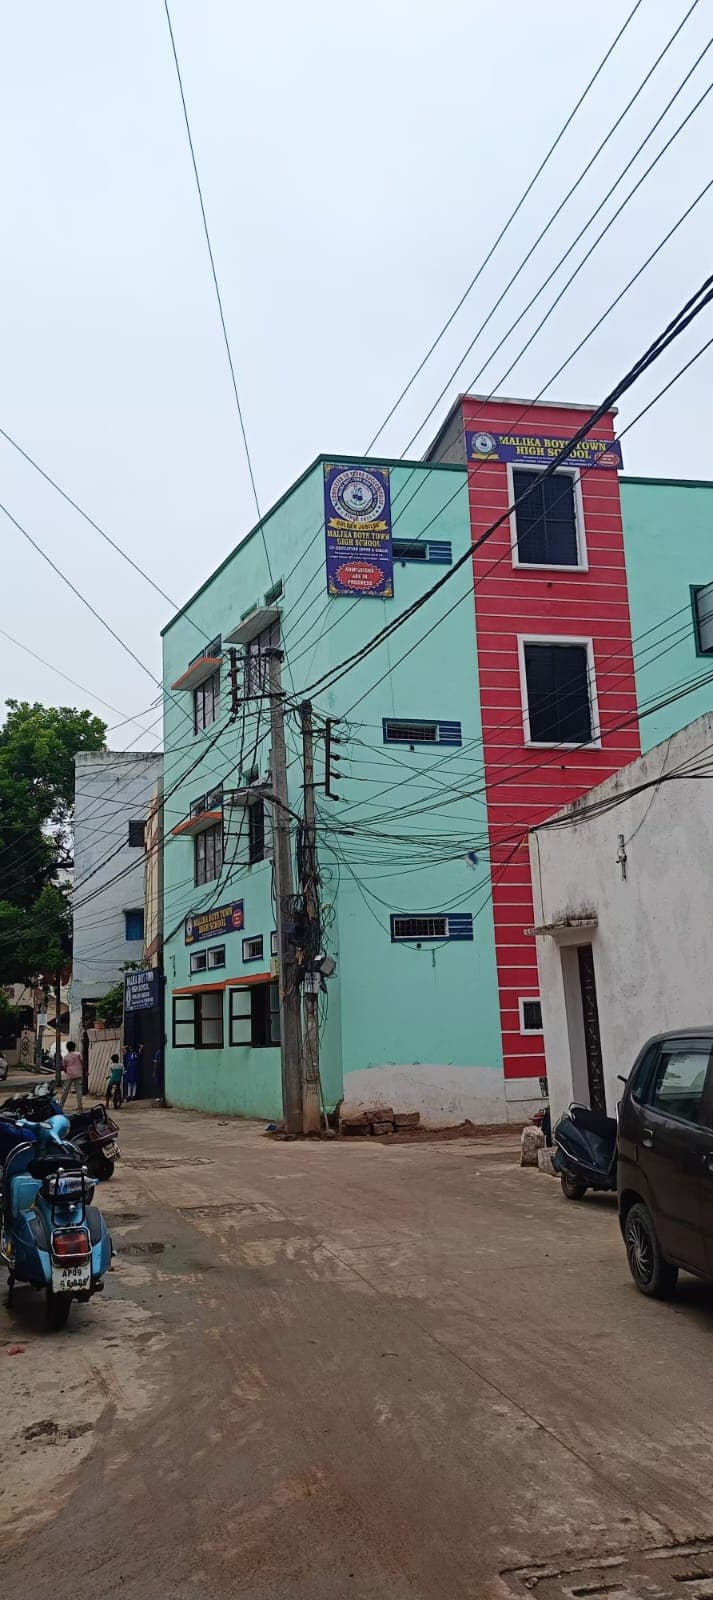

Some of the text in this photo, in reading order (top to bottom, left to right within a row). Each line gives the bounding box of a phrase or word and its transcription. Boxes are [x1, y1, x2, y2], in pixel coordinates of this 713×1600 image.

[499, 436, 541, 446] MALIKA
[576, 441, 606, 451] TOWN
[516, 446, 544, 456] HIGH
[547, 448, 591, 459] SCOOL
[327, 529, 352, 538] MALIKA
